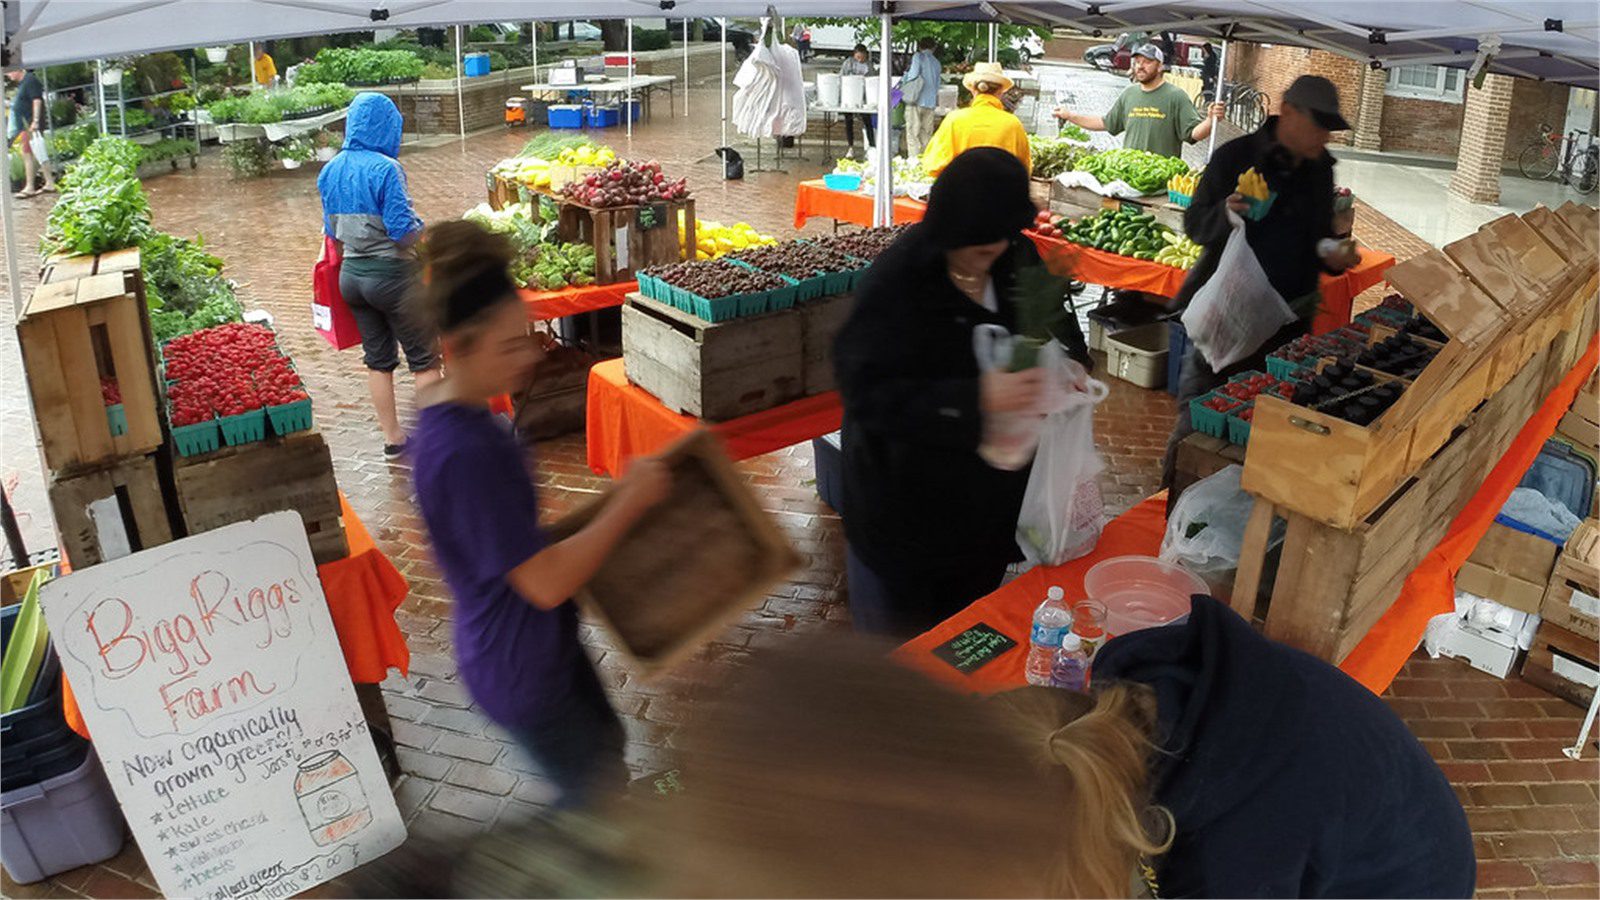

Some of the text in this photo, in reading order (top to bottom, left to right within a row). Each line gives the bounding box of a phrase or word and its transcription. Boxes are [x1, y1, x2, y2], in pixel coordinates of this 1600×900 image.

[83, 569, 301, 680] Bigg Riggs
[159, 670, 276, 732] Farm
[181, 706, 304, 766] organically
[326, 732, 339, 747] 3
[154, 763, 215, 810] grown
